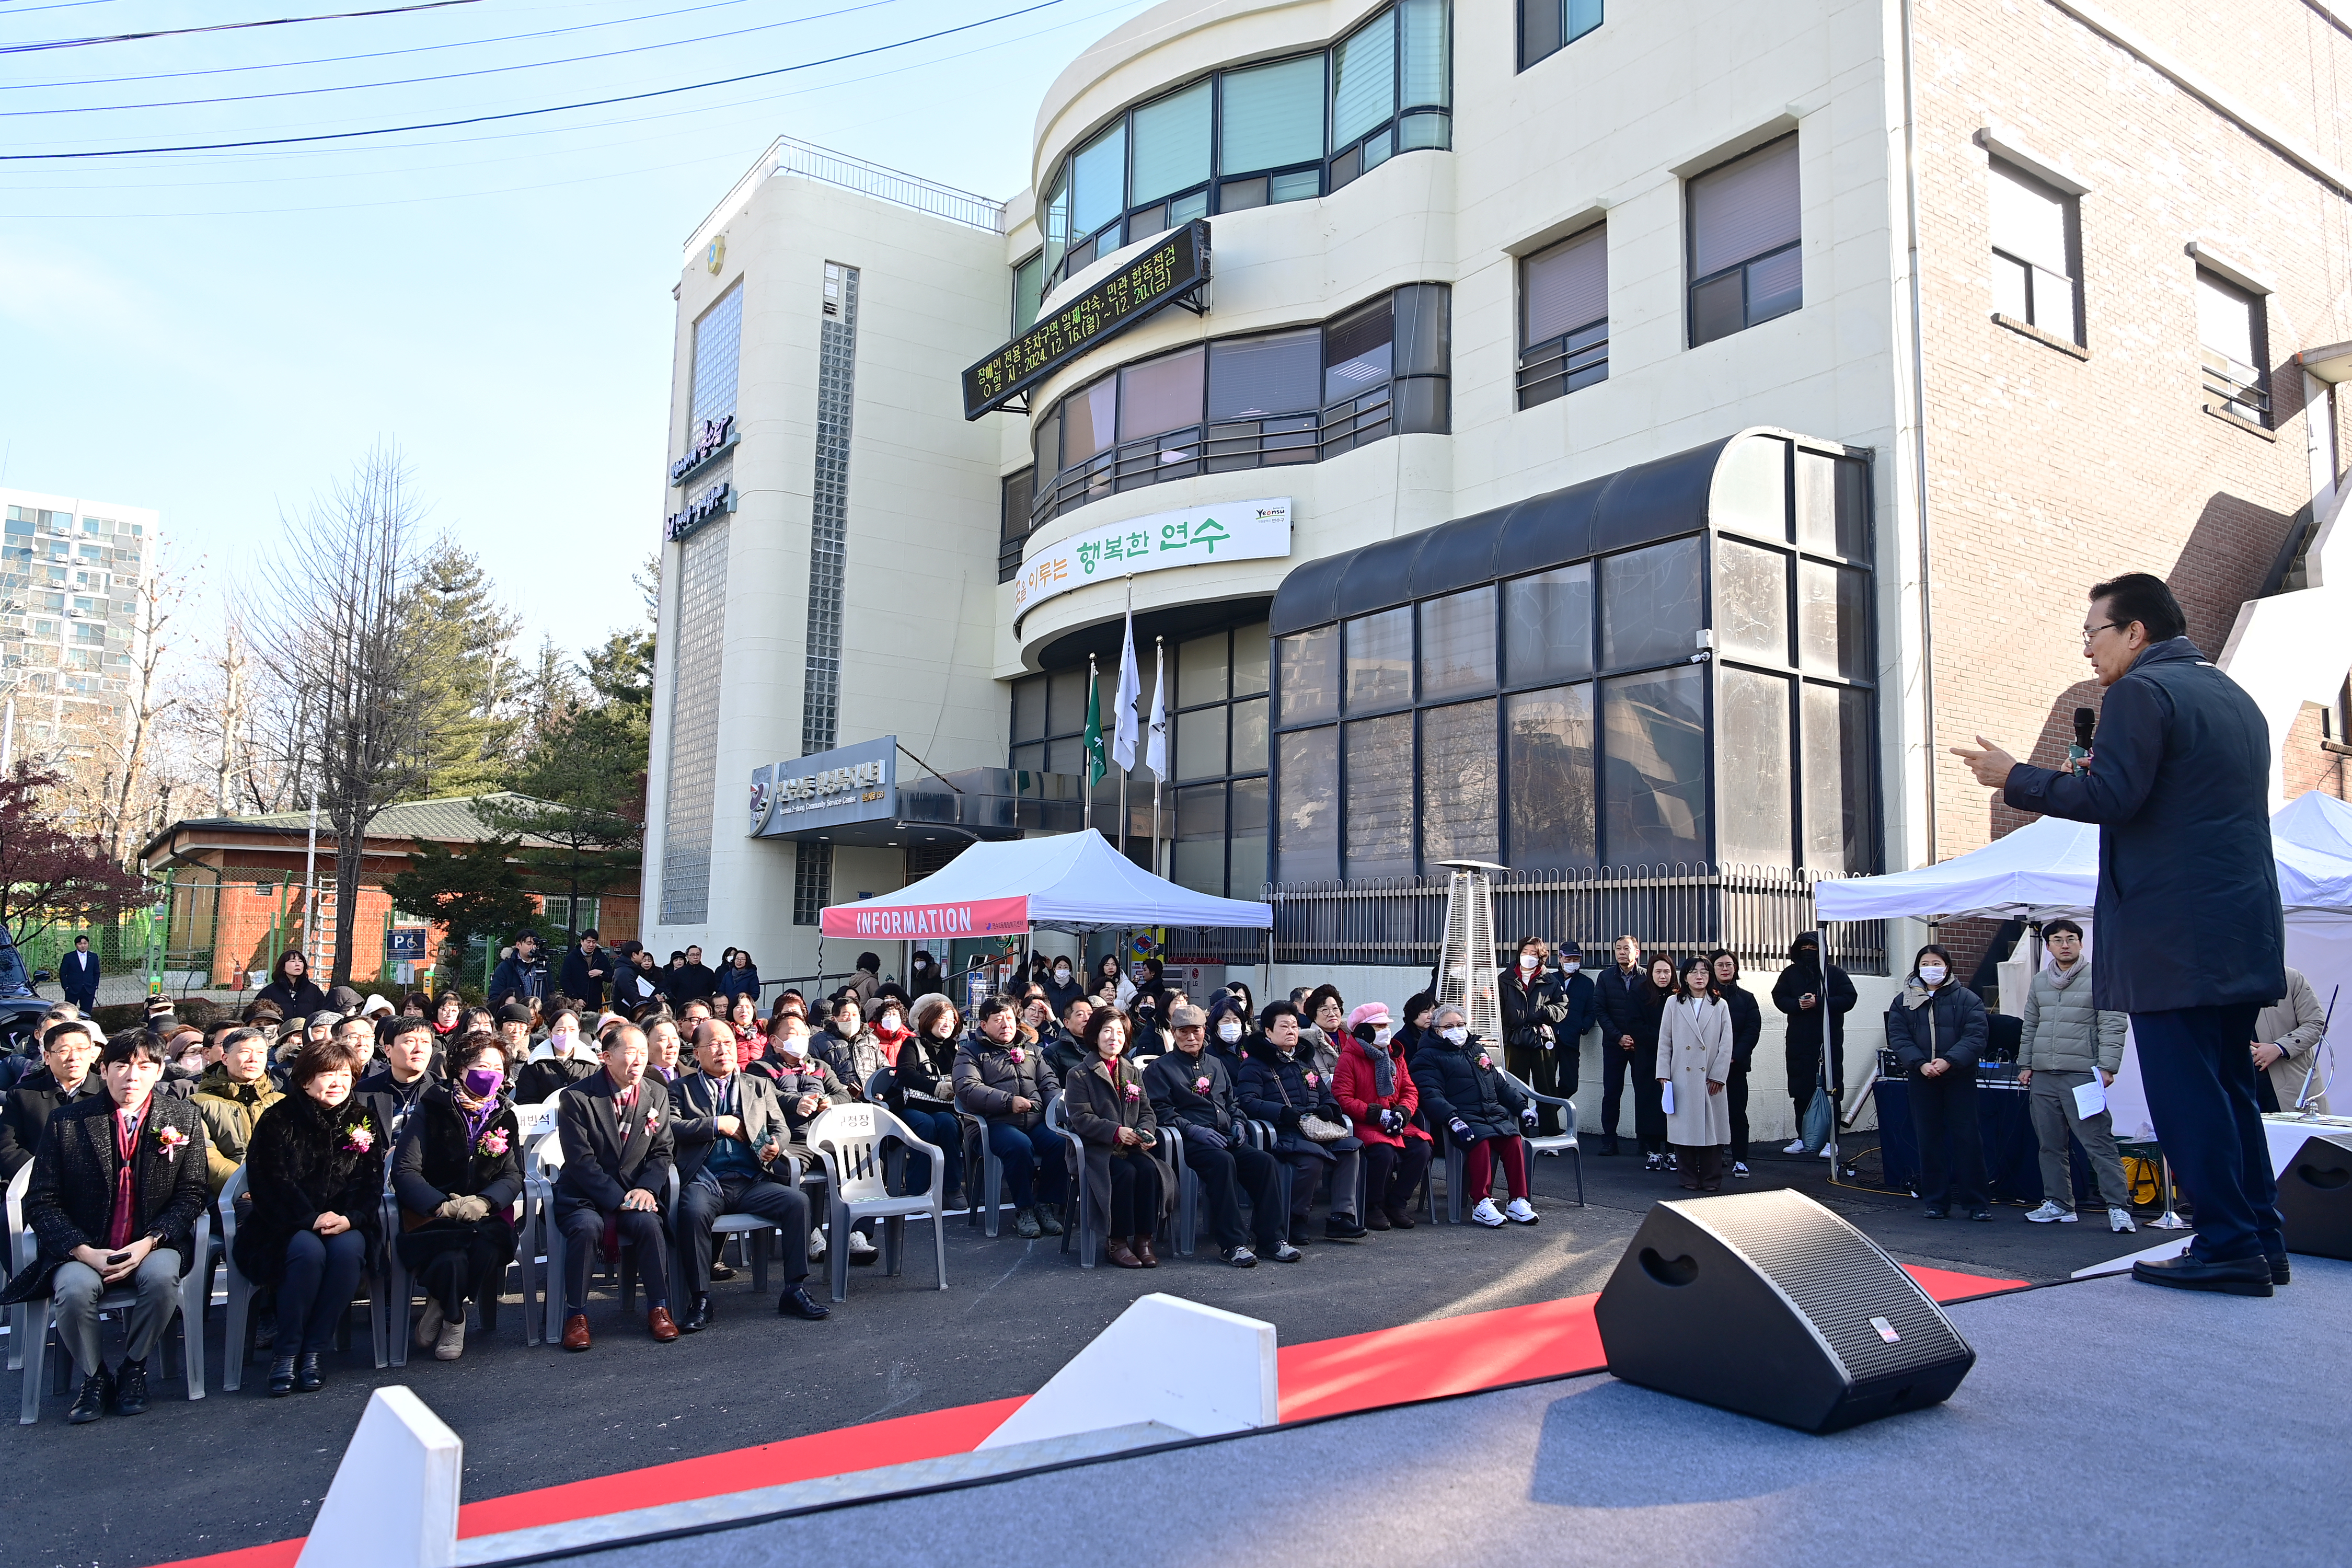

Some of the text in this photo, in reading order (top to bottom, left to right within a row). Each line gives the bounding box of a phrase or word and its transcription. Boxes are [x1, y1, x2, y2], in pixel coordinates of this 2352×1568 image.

[977, 356, 1001, 385] 장애인
[1004, 344, 1021, 368] 전용
[1024, 320, 1059, 355] 주차구역
[1062, 294, 1104, 331] 일제단속,
[1107, 275, 1128, 303] 민관
[1024, 348, 1047, 373] 2024.
[1051, 337, 1064, 355] 12.
[1115, 295, 1130, 316] 12.
[1255, 509, 1285, 518] Yeonsu
[1029, 558, 1068, 592] 이루는
[1076, 530, 1149, 574] 행복한
[1159, 517, 1231, 554] 연수
[805, 800, 826, 810] Community
[826, 798, 842, 807] Service
[843, 795, 857, 804] Center
[856, 906, 972, 934] INFORMATION
[395, 935, 405, 948] P
